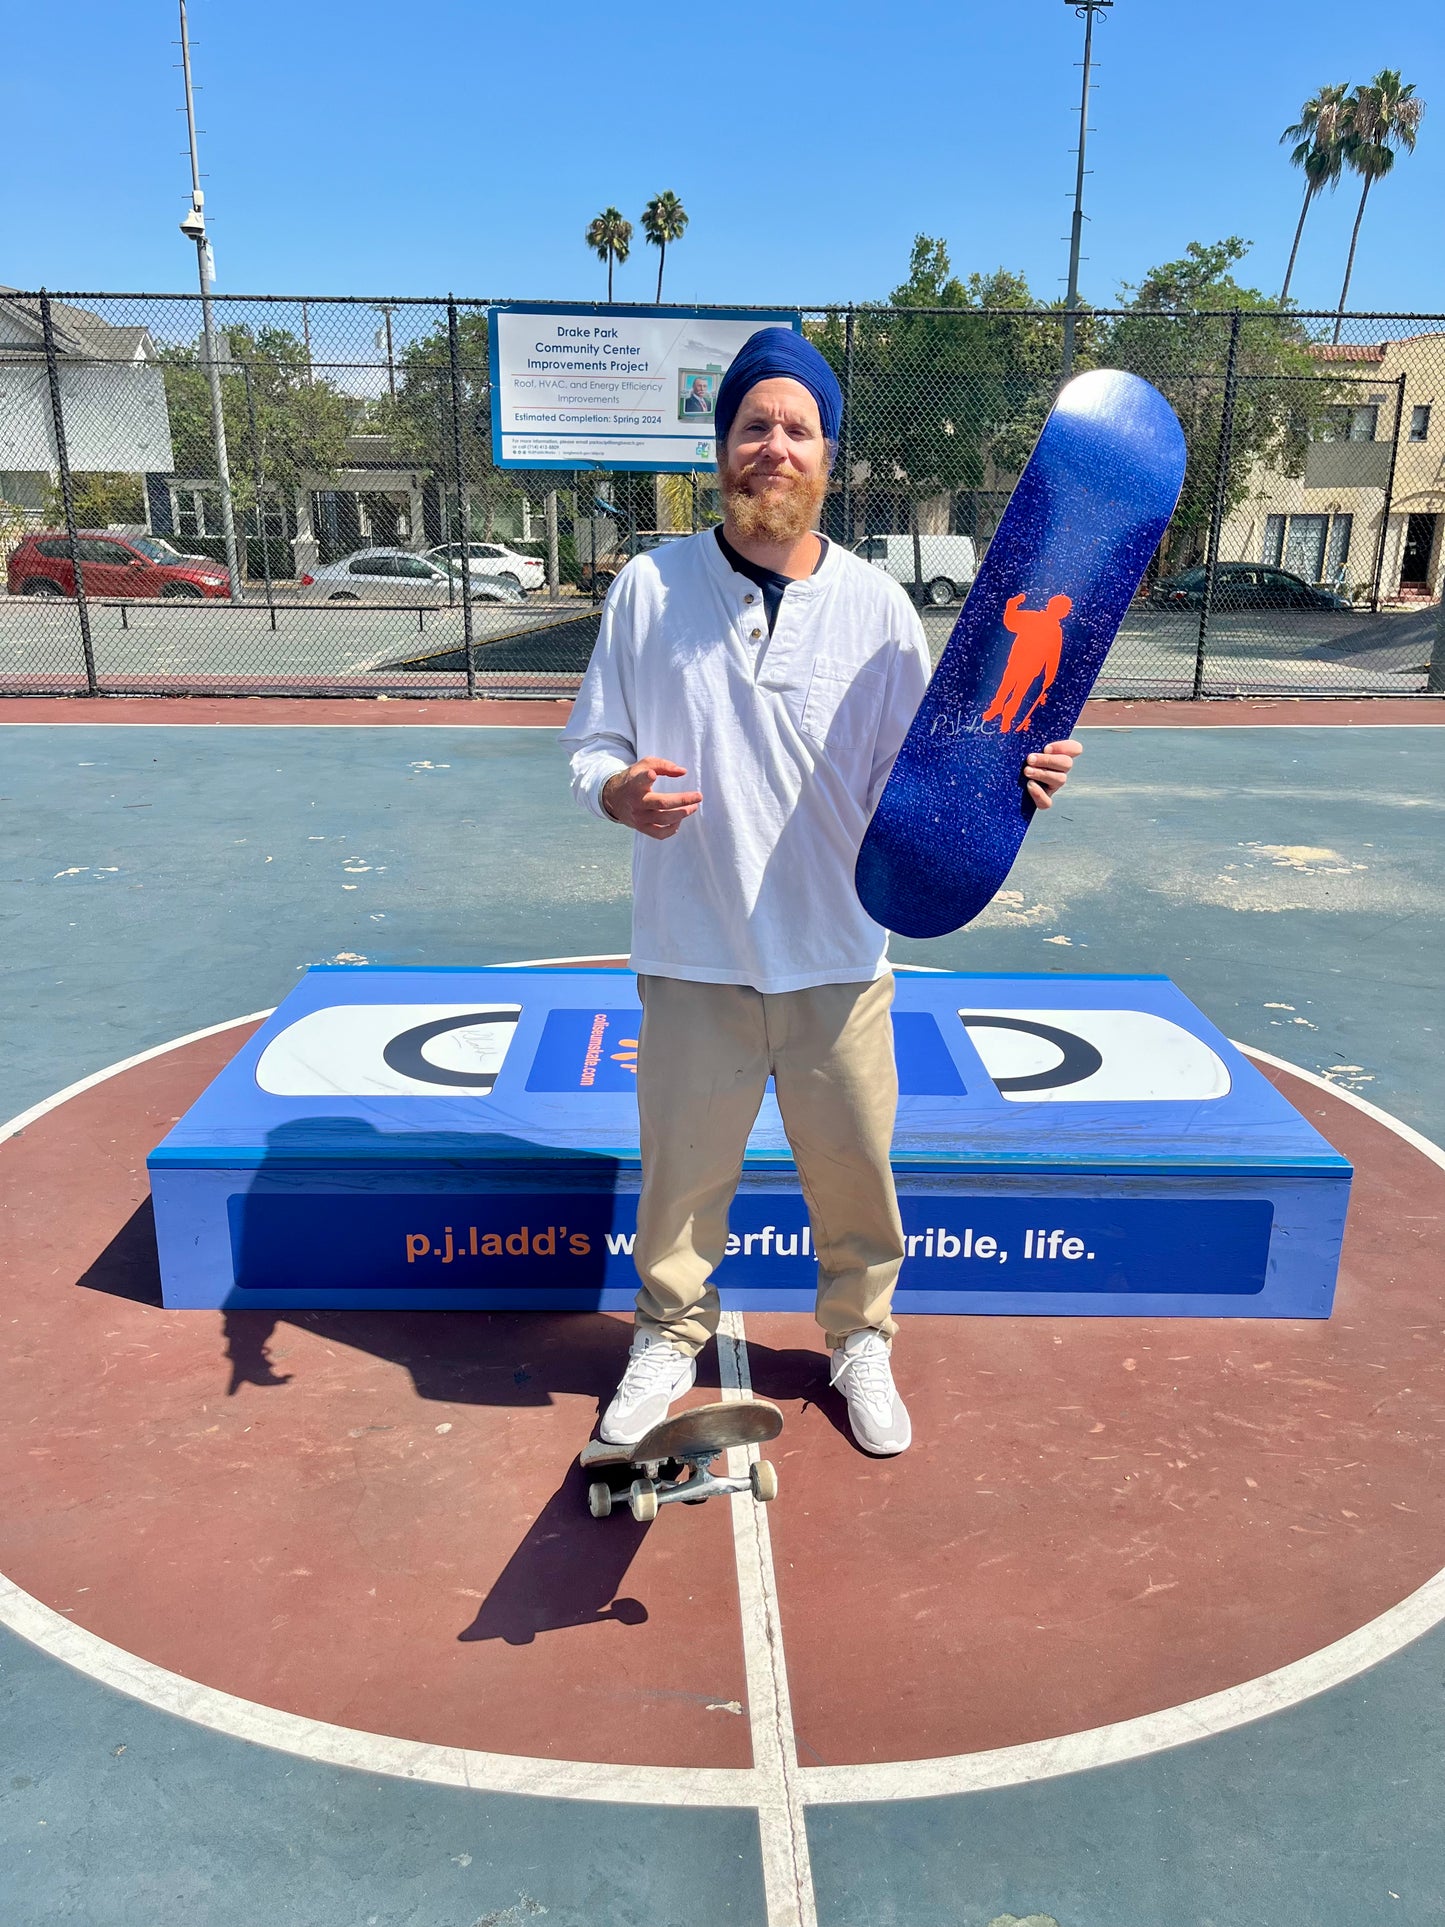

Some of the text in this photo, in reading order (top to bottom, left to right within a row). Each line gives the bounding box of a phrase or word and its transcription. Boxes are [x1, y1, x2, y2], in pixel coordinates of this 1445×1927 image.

[557, 326, 619, 338] Drake Park
[535, 342, 641, 356] Community Center
[527, 358, 649, 373] Improvements Project
[514, 379, 663, 393] Roof, HVAC, and Energy Efficiency
[557, 394, 620, 405] Improvements
[514, 412, 662, 425] Estimated Completion: Spring 2024
[406, 1226, 591, 1263] p.j.ladd's
[604, 1226, 819, 1262] werful,
[1023, 1229, 1096, 1261] life.
